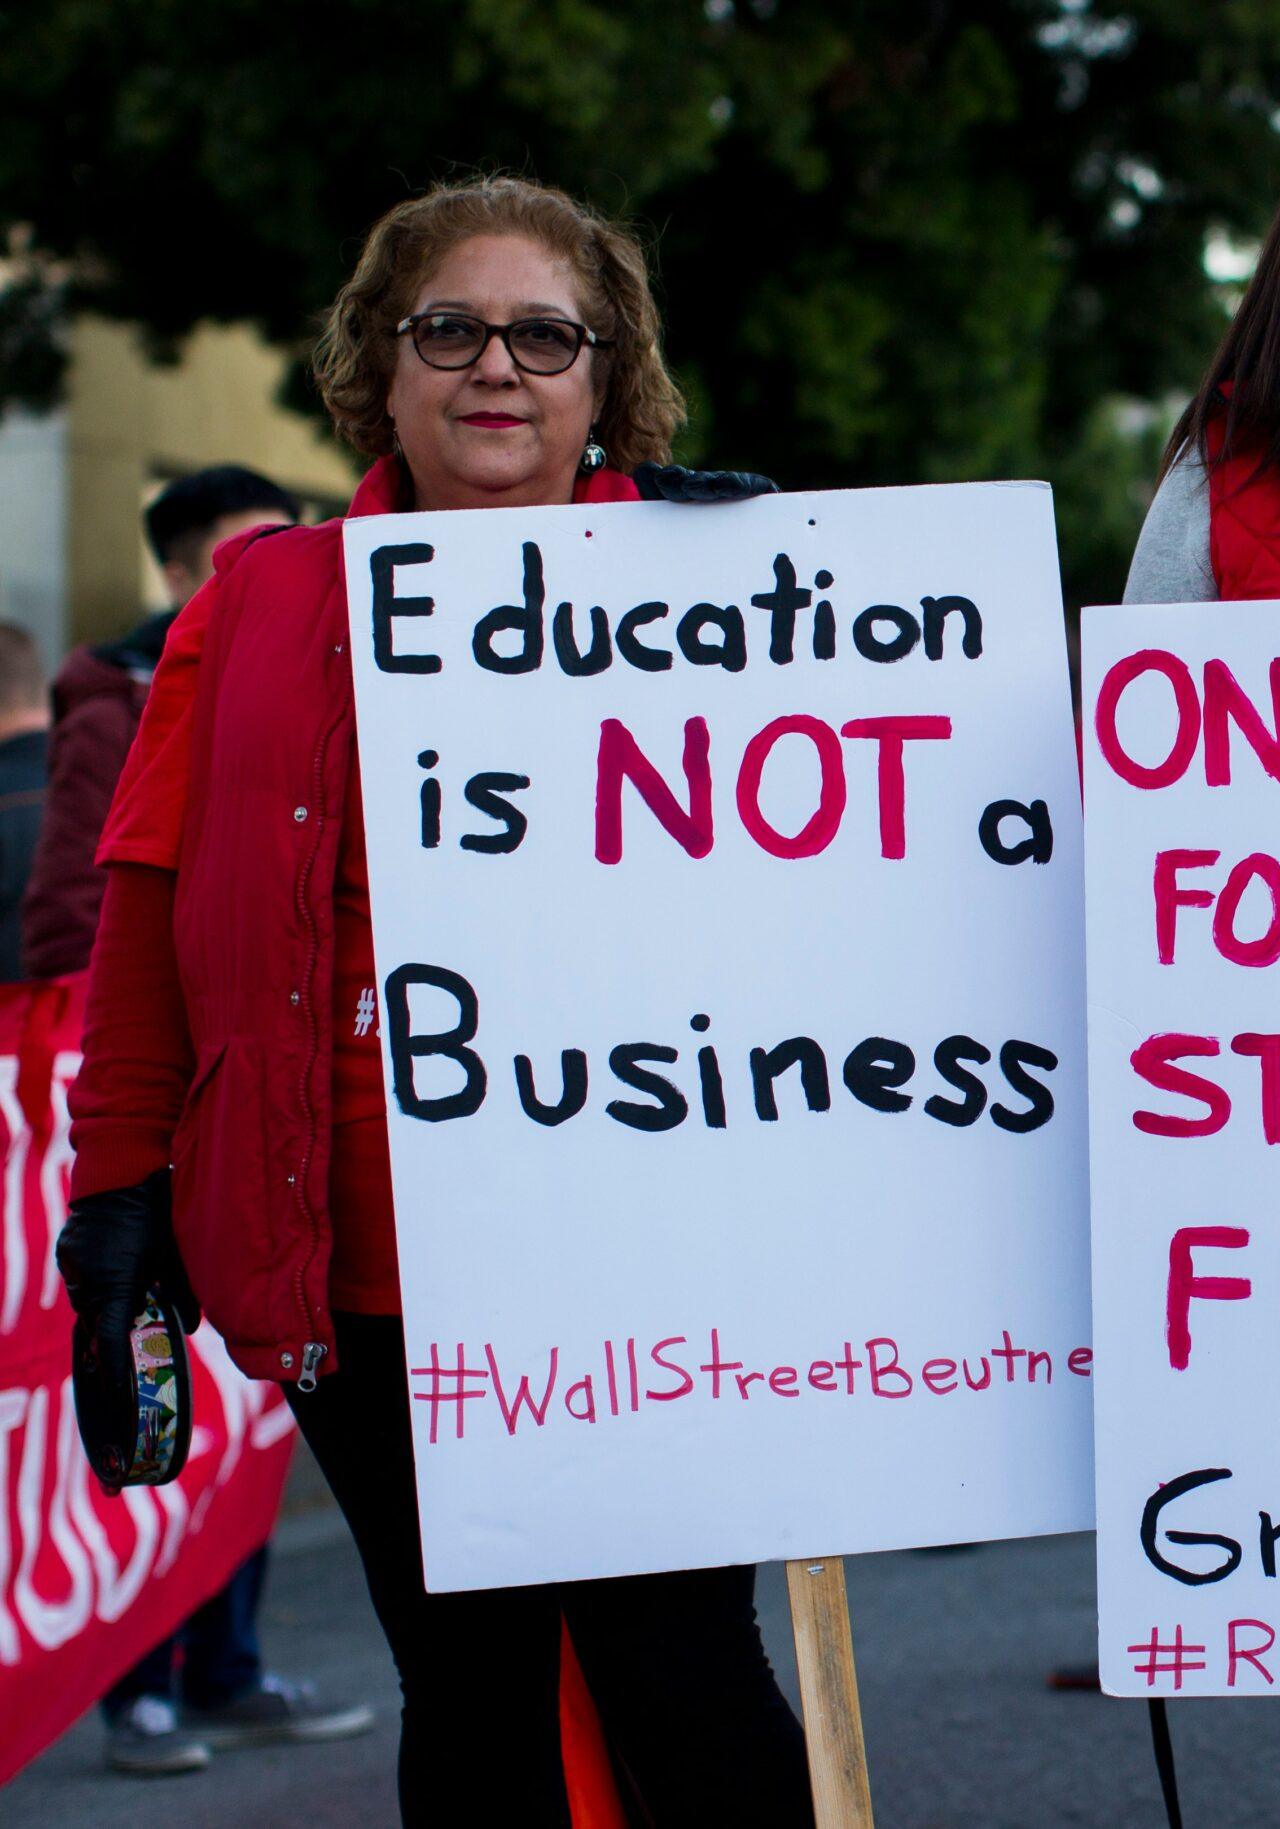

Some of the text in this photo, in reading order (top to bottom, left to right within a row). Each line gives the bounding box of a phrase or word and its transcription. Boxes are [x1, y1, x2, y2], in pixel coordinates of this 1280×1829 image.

[370, 541, 983, 677] Education
[417, 715, 1054, 866] is NOT a
[384, 962, 1059, 1134] Business
